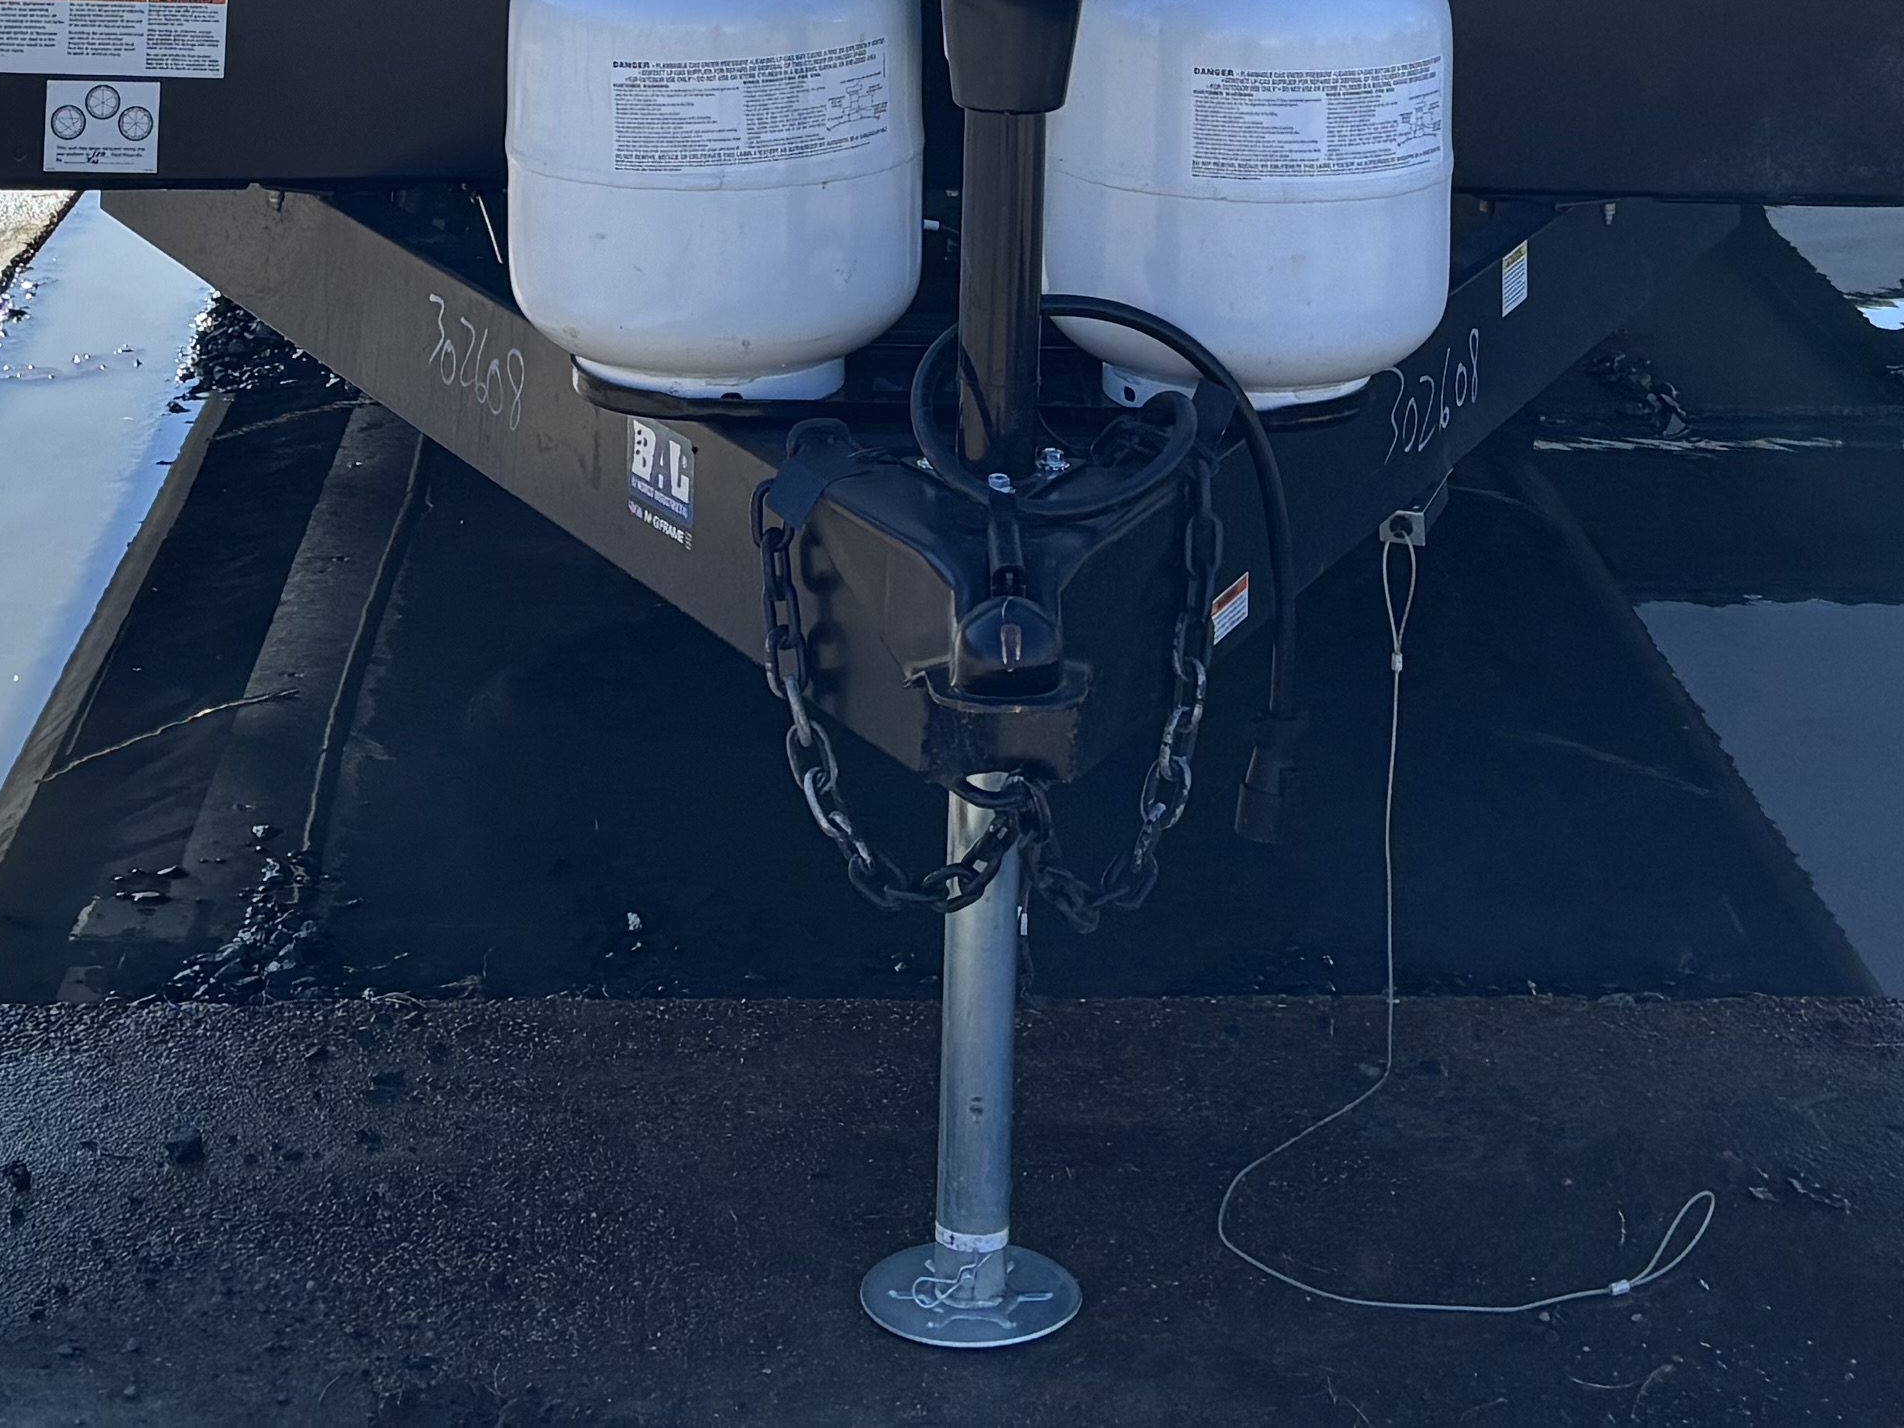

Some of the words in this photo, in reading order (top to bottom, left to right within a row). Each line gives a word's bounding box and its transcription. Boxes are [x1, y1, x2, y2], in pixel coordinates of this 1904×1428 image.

[612, 61, 650, 69] DANGER
[1193, 67, 1234, 77] DANGER
[428, 293, 525, 431] 302608
[1379, 328, 1479, 464] 302608
